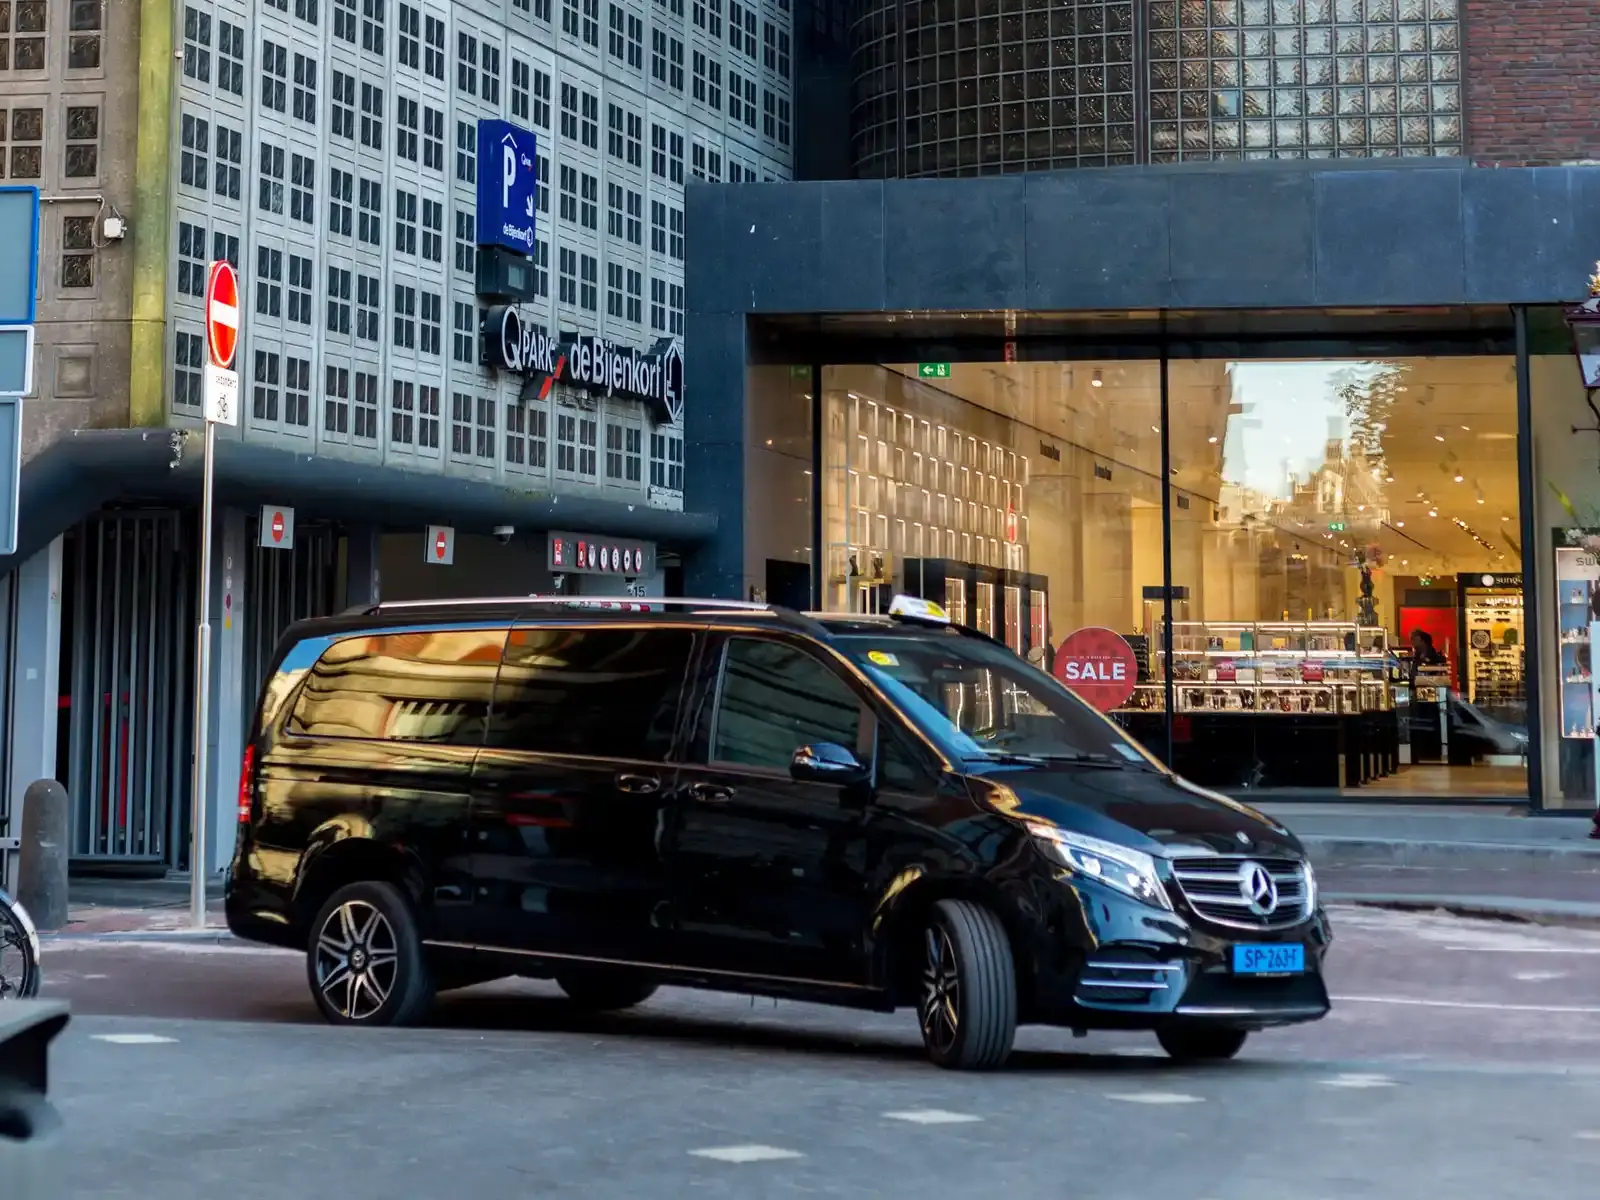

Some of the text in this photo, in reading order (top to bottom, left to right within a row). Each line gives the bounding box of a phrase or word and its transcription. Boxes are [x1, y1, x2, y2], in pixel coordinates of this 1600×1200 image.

[503, 144, 516, 208] P
[570, 333, 662, 398] de Bijenkorf
[1065, 661, 1126, 681] SALE
